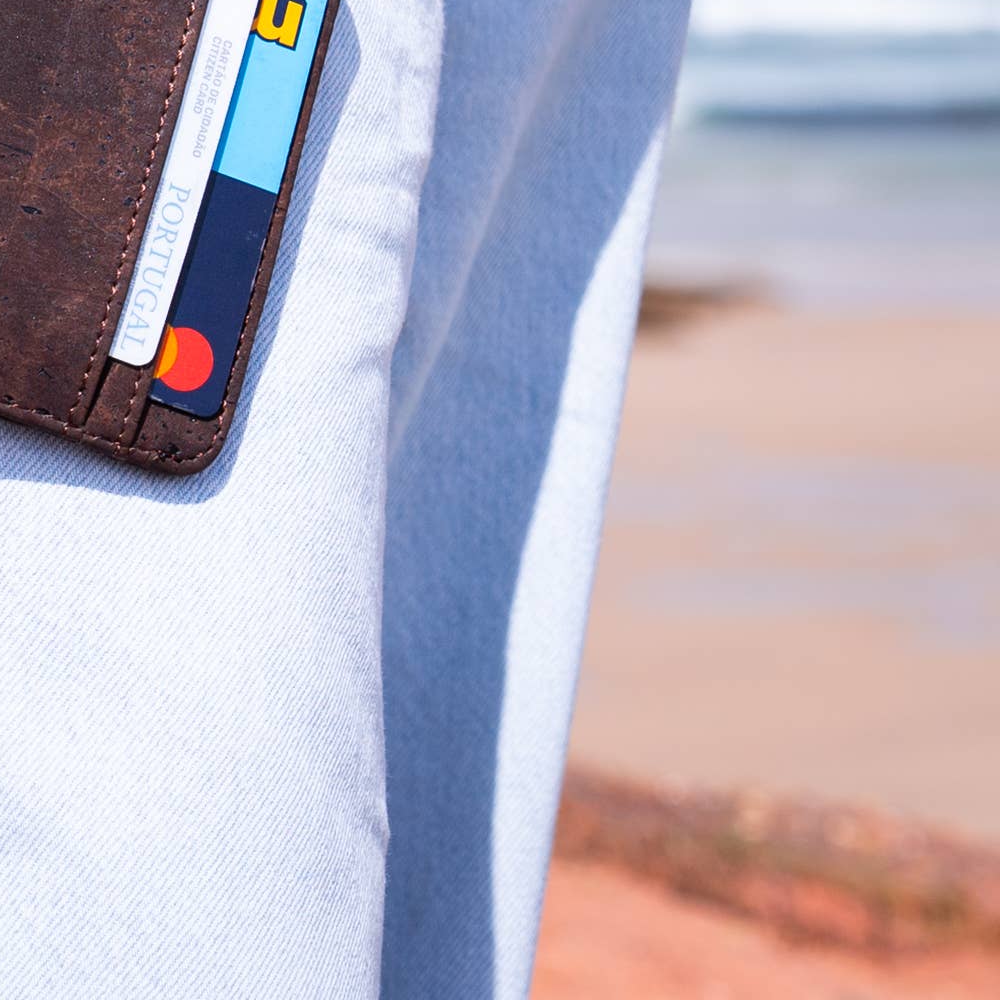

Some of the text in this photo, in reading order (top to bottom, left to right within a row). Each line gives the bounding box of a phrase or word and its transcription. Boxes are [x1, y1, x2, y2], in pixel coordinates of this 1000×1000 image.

[192, 40, 232, 158] CARTÃO DE CIDADÃO
[193, 36, 222, 114] CITIZEN CARD
[120, 182, 192, 350] PORTUGAL
